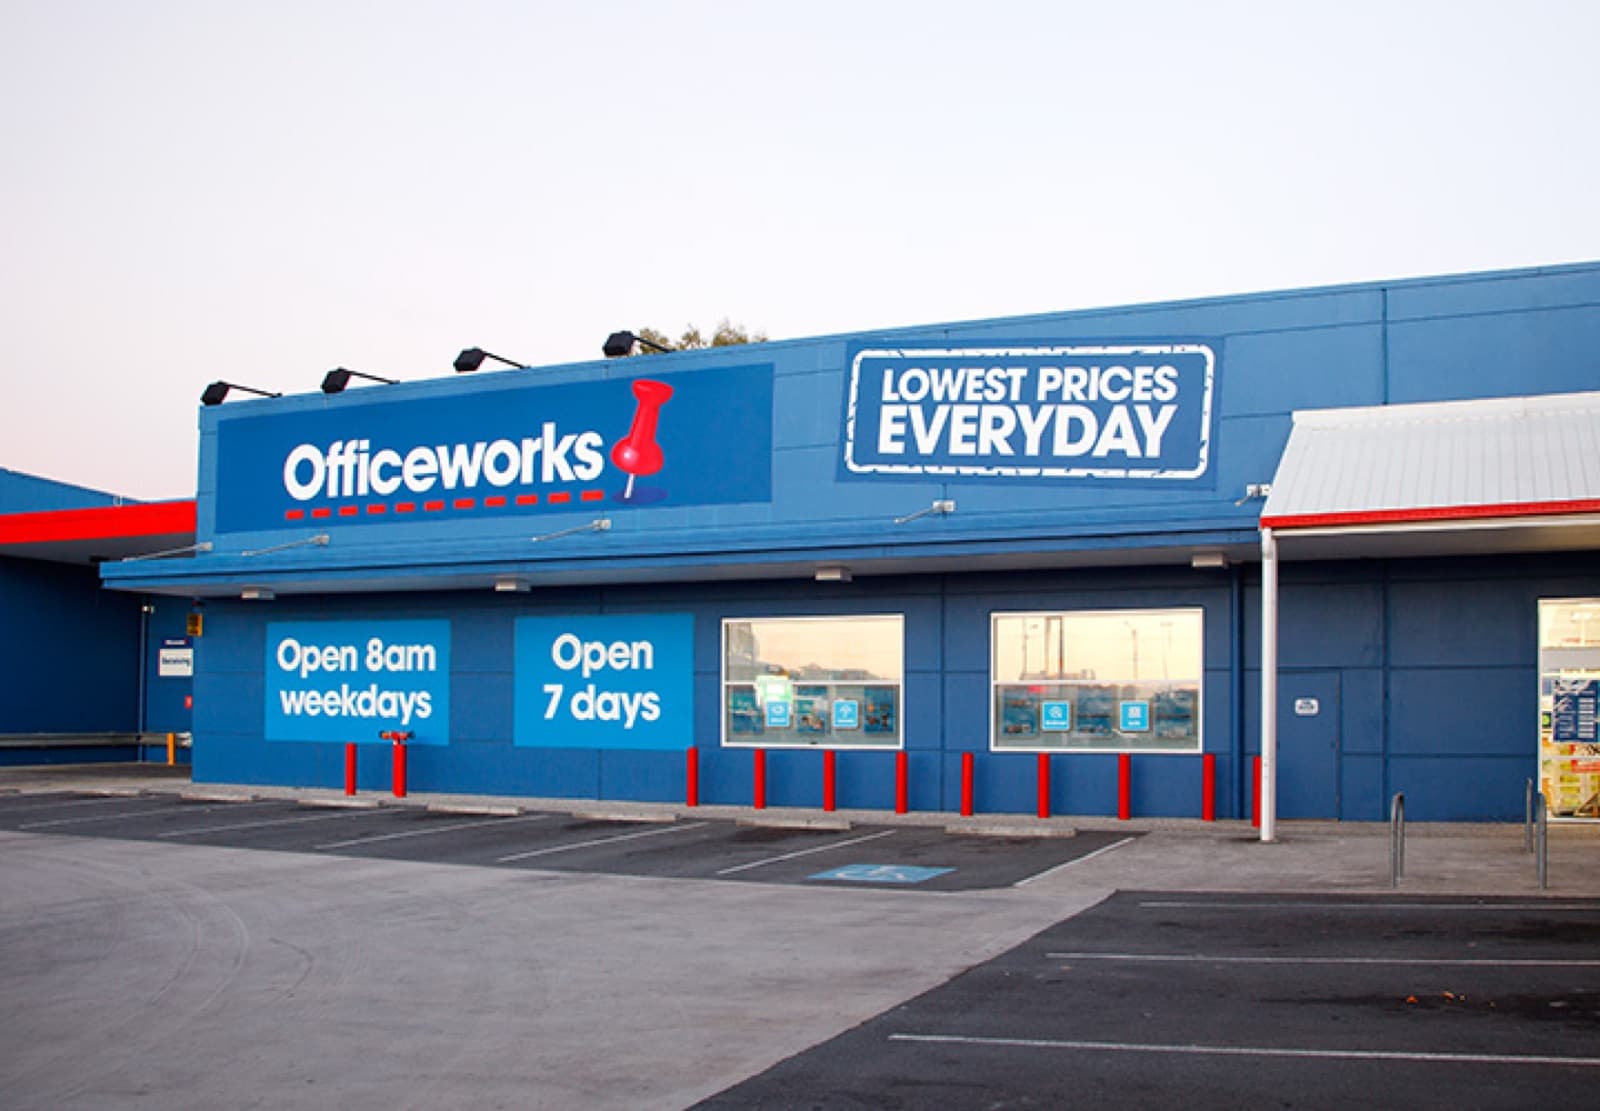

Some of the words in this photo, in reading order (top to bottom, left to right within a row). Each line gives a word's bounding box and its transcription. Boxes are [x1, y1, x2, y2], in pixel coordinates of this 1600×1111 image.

[882, 368, 1027, 402] LOWEST
[1037, 366, 1178, 401] PRICES
[878, 404, 1177, 457] EVERYDAY
[284, 423, 603, 500] Officeworks
[278, 639, 357, 678] Open
[366, 638, 435, 671] 8am
[553, 634, 652, 677] Open
[280, 684, 431, 724] weekdays
[544, 685, 562, 718] 7
[571, 685, 660, 728] days
